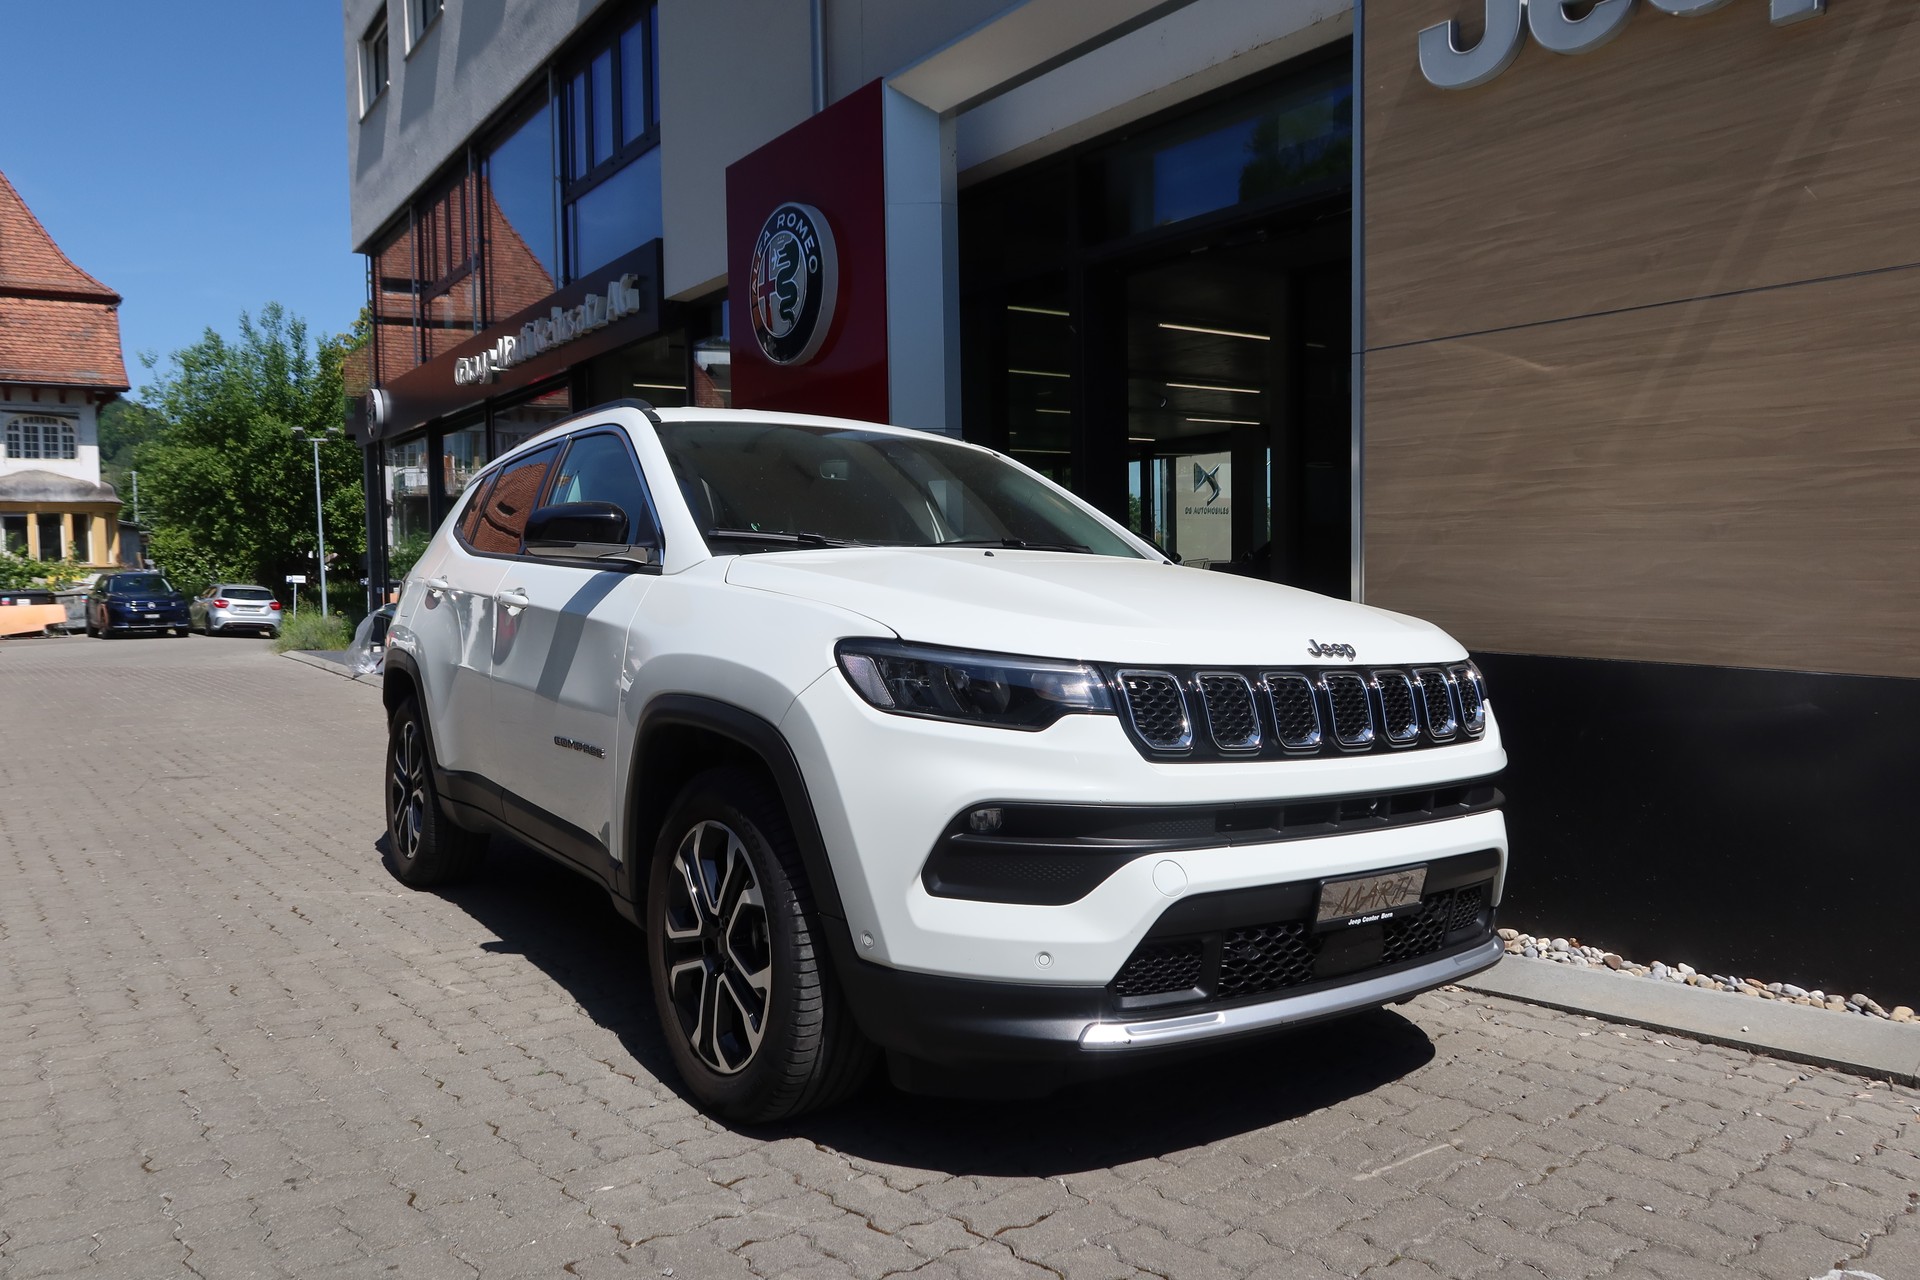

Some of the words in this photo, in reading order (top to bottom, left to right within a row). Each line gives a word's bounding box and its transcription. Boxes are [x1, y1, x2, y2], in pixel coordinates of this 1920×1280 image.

[752, 230, 770, 294] ALFA
[776, 212, 818, 274] ROMEO
[1307, 639, 1357, 662] Jeep
[1348, 918, 1362, 926] Jeep
[1362, 914, 1380, 923] Center
[1380, 911, 1394, 919] Bern
